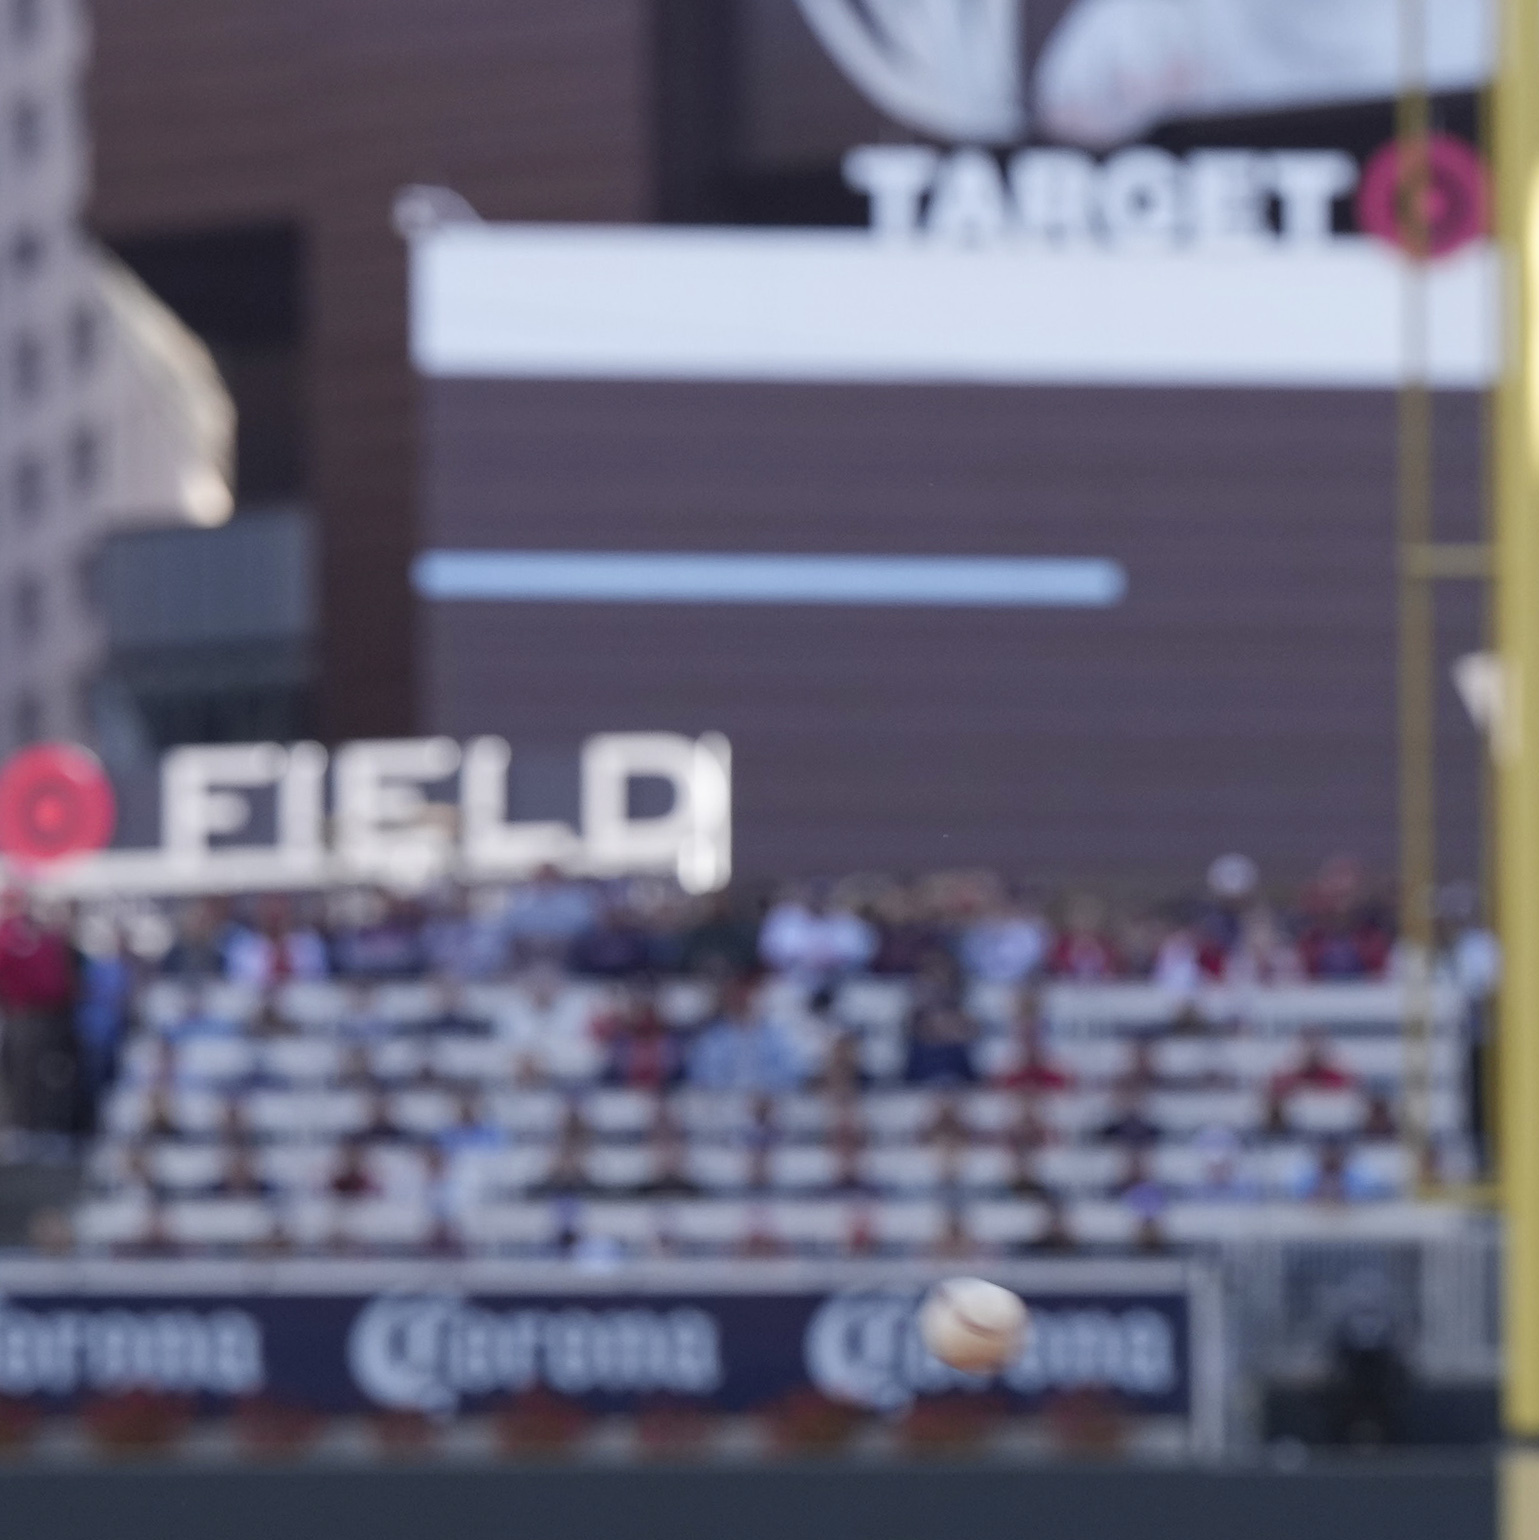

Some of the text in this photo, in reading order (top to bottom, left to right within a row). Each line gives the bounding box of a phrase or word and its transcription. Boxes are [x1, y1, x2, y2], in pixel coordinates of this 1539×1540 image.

[841, 145, 1360, 254] TARGET
[160, 730, 732, 882] FIELD
[0, 1306, 262, 1397] orona
[347, 1283, 724, 1414] Corona
